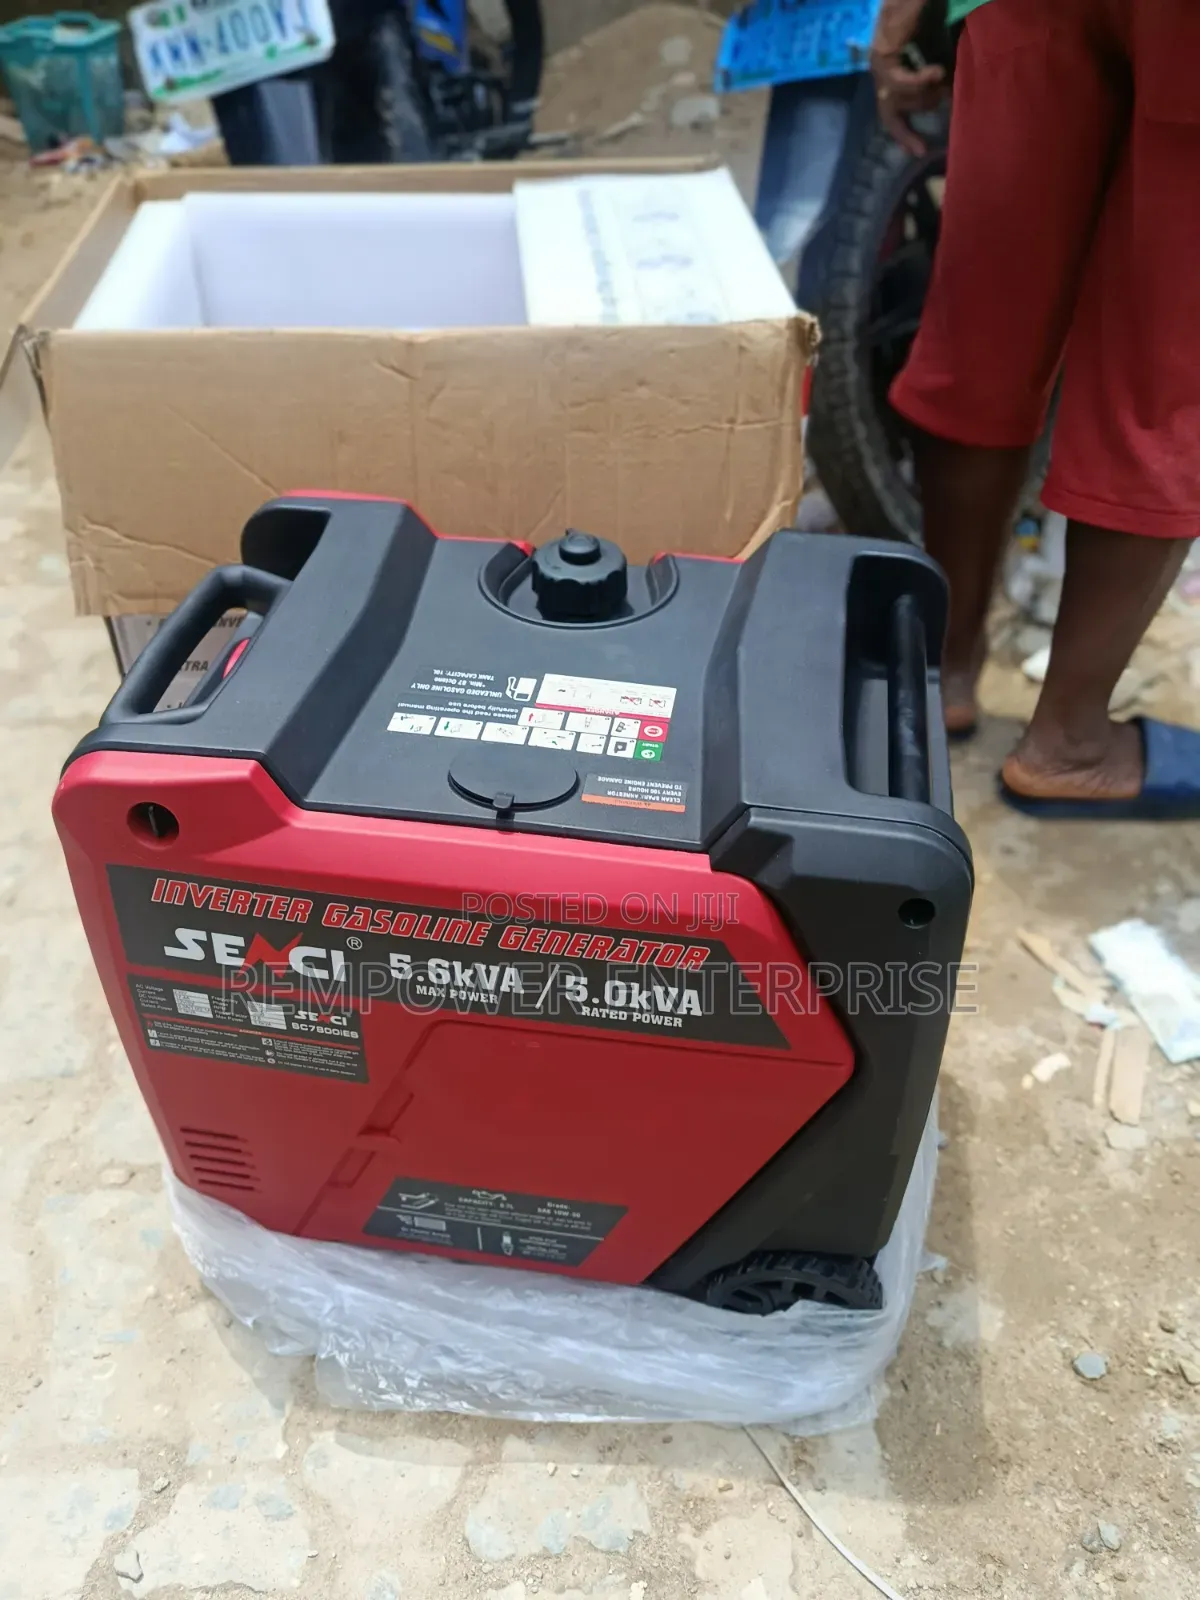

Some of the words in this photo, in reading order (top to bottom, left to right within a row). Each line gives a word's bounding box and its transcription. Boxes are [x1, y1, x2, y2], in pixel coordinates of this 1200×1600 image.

[180, 661, 209, 671] TRA
[434, 677, 457, 685] Octane
[478, 673, 494, 681] TANK
[411, 682, 430, 690] ONLY
[431, 684, 465, 694] GASOLINE
[466, 688, 503, 698] UNLEADED
[425, 704, 460, 713] operating
[463, 702, 487, 710] before
[487, 704, 519, 713] carefully
[492, 711, 517, 719] please
[597, 776, 623, 784] DAMAGE
[628, 785, 649, 793] HOURS
[646, 781, 673, 789] PREVENT
[606, 790, 638, 799] ARRESTOR
[150, 877, 313, 923] INVERTER
[321, 902, 492, 946] GASOLINE
[498, 925, 710, 972] GENERATOR
[163, 927, 347, 981] SENCI
[145, 984, 164, 992] Voltage
[389, 952, 525, 994] 5.6kVA
[565, 975, 702, 1017] 5.0kVA
[147, 994, 166, 1002] Voltage
[416, 984, 445, 998] MAX
[449, 988, 499, 1004] POWER
[294, 1010, 348, 1026] SENCI
[582, 1005, 628, 1021] RATED
[632, 1012, 683, 1027] POWER
